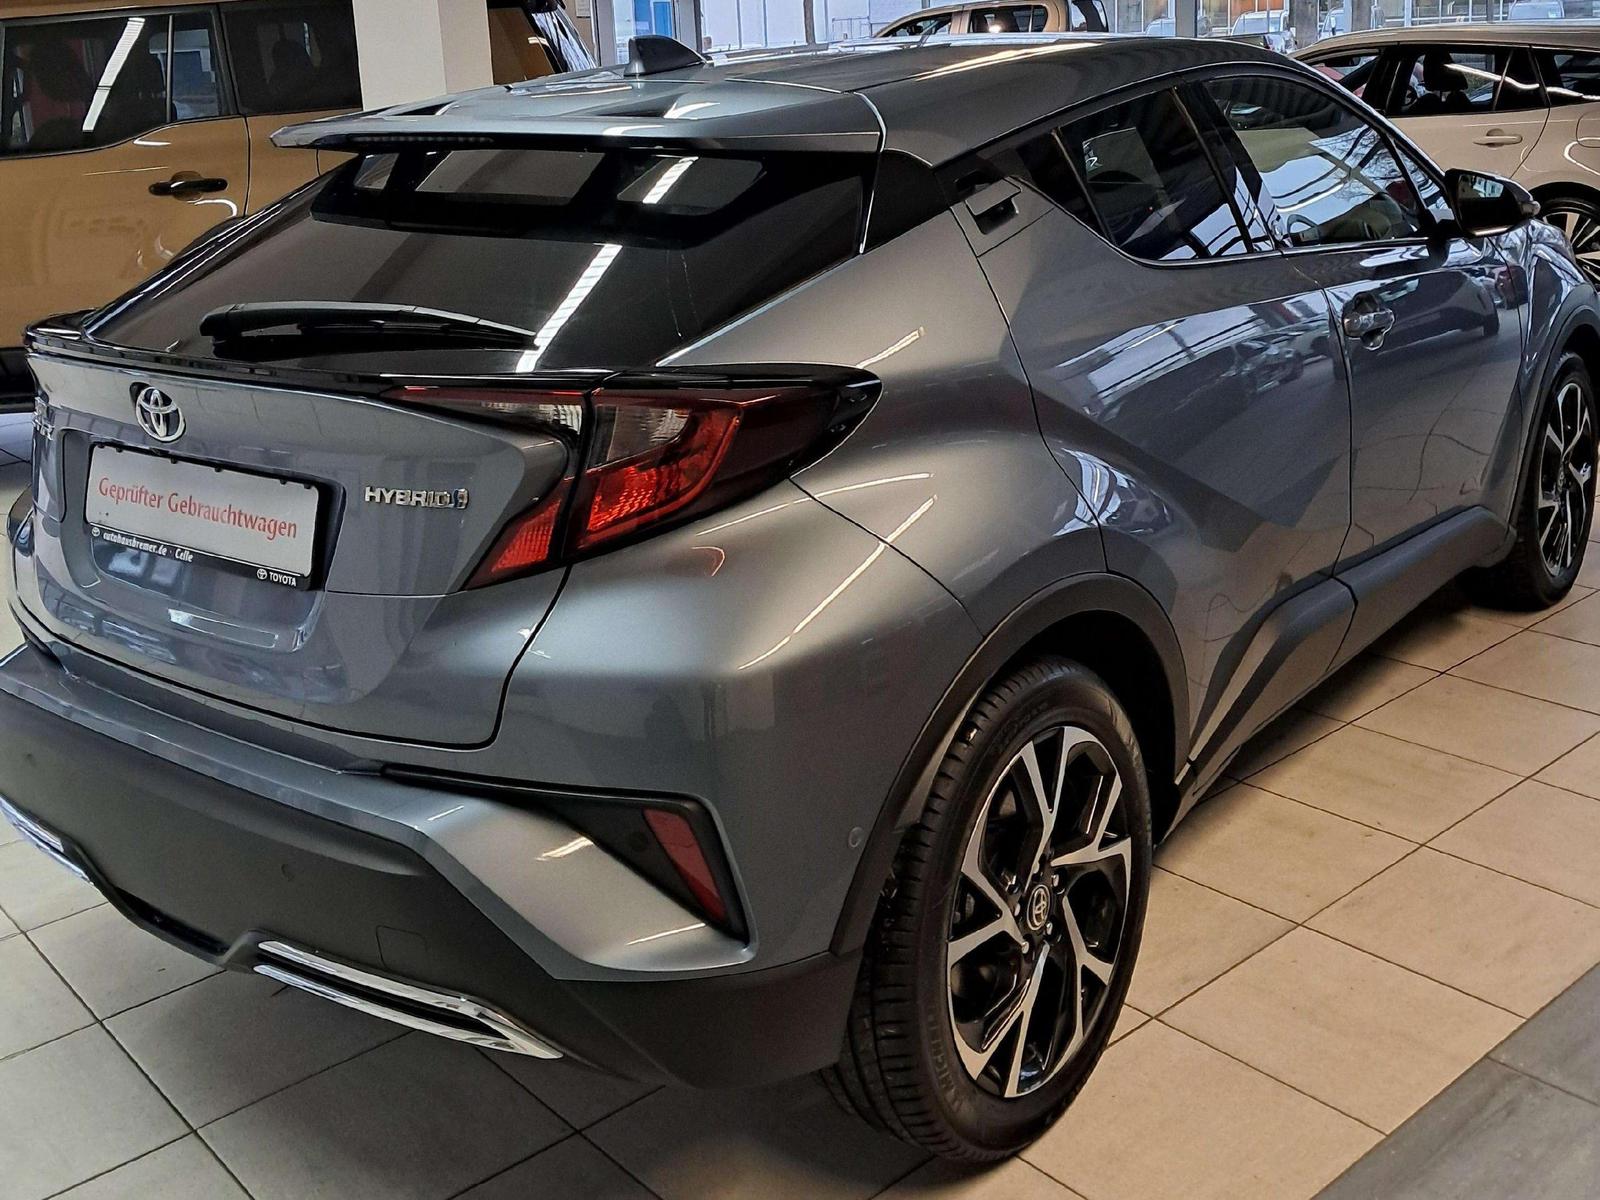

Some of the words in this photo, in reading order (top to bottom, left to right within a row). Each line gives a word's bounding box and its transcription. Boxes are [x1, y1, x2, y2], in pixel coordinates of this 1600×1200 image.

[364, 486, 451, 508] HYBRID
[99, 477, 163, 508] Geprüfter
[168, 492, 297, 541] Gebrauchtwagen
[269, 571, 297, 587] TOYOTA
